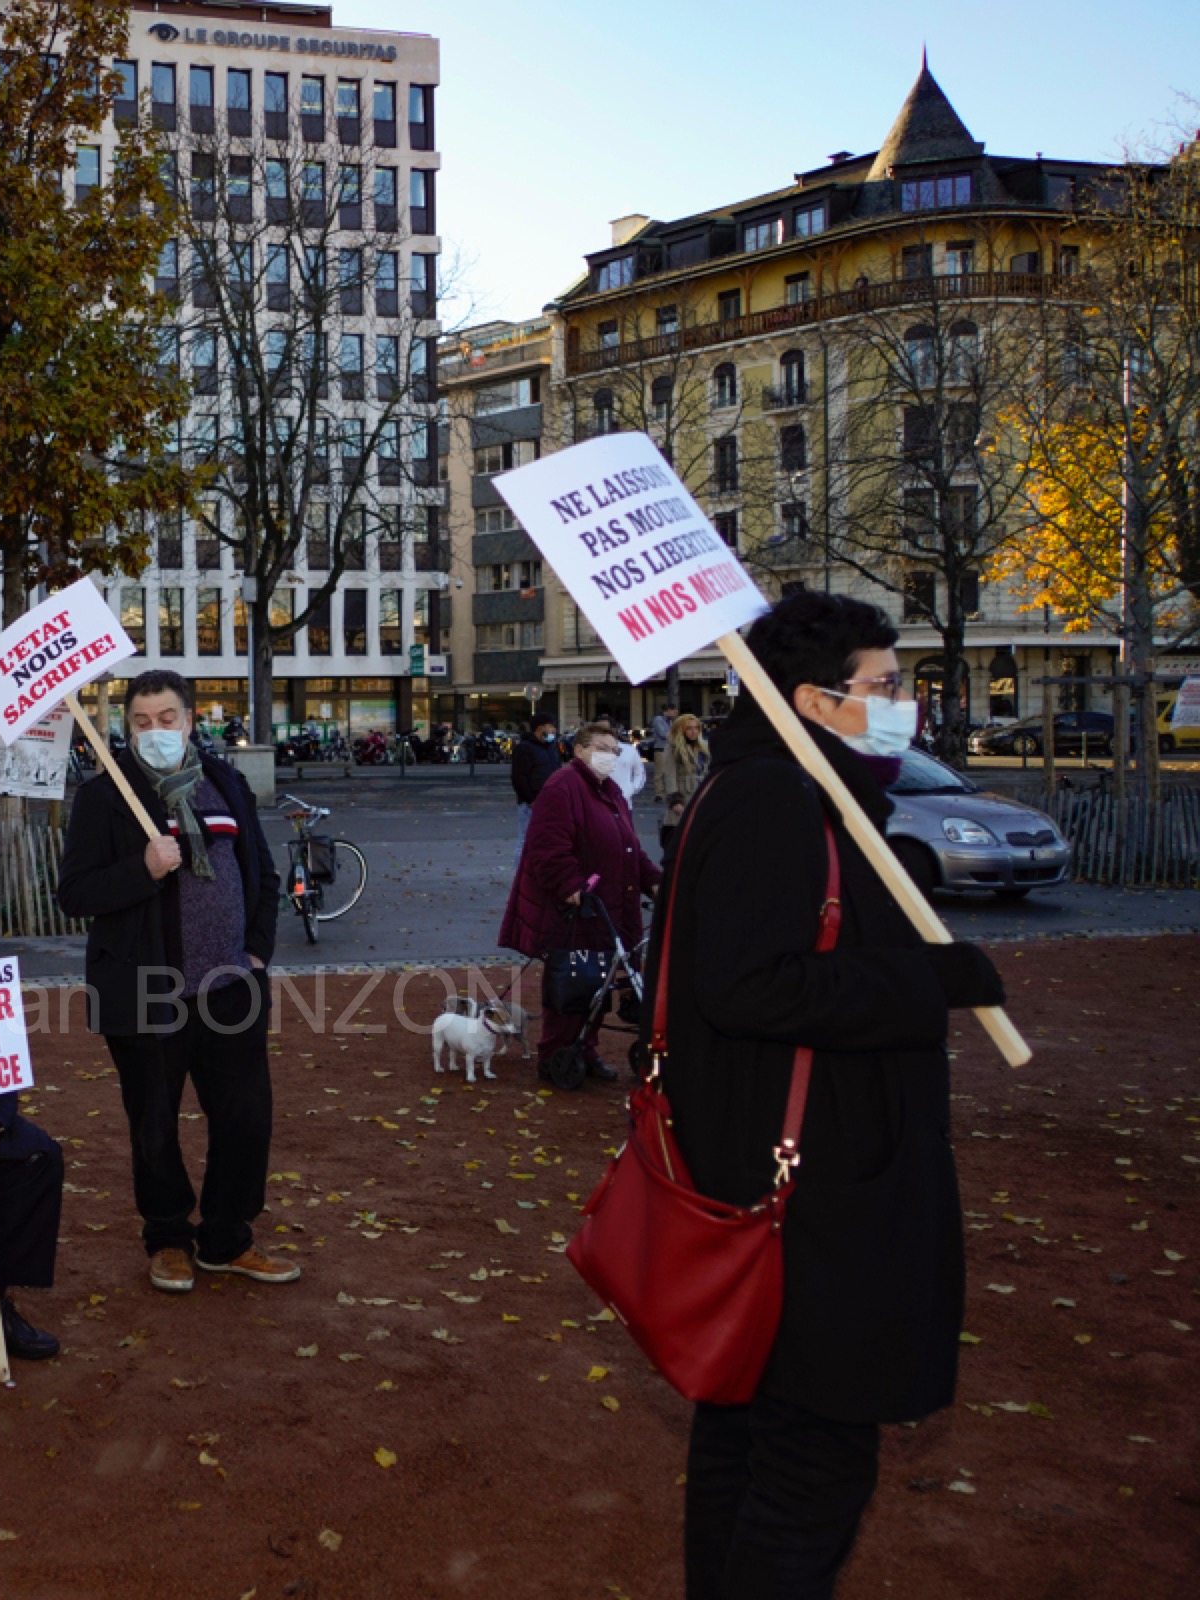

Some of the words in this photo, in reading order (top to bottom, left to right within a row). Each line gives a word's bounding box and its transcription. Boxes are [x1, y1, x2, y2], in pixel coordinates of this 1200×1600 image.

[184, 27, 207, 44] LE
[213, 29, 290, 52] GROUPE
[295, 37, 398, 60] SECURITAS
[550, 490, 591, 524] NE
[586, 464, 672, 508] LAISSONS
[578, 518, 631, 557] PAS
[590, 557, 646, 600] NOS
[617, 604, 654, 642] NI
[644, 581, 698, 629] NOS
[3, 633, 117, 725] SACRIFIE!
[11, 631, 78, 688] NOUS
